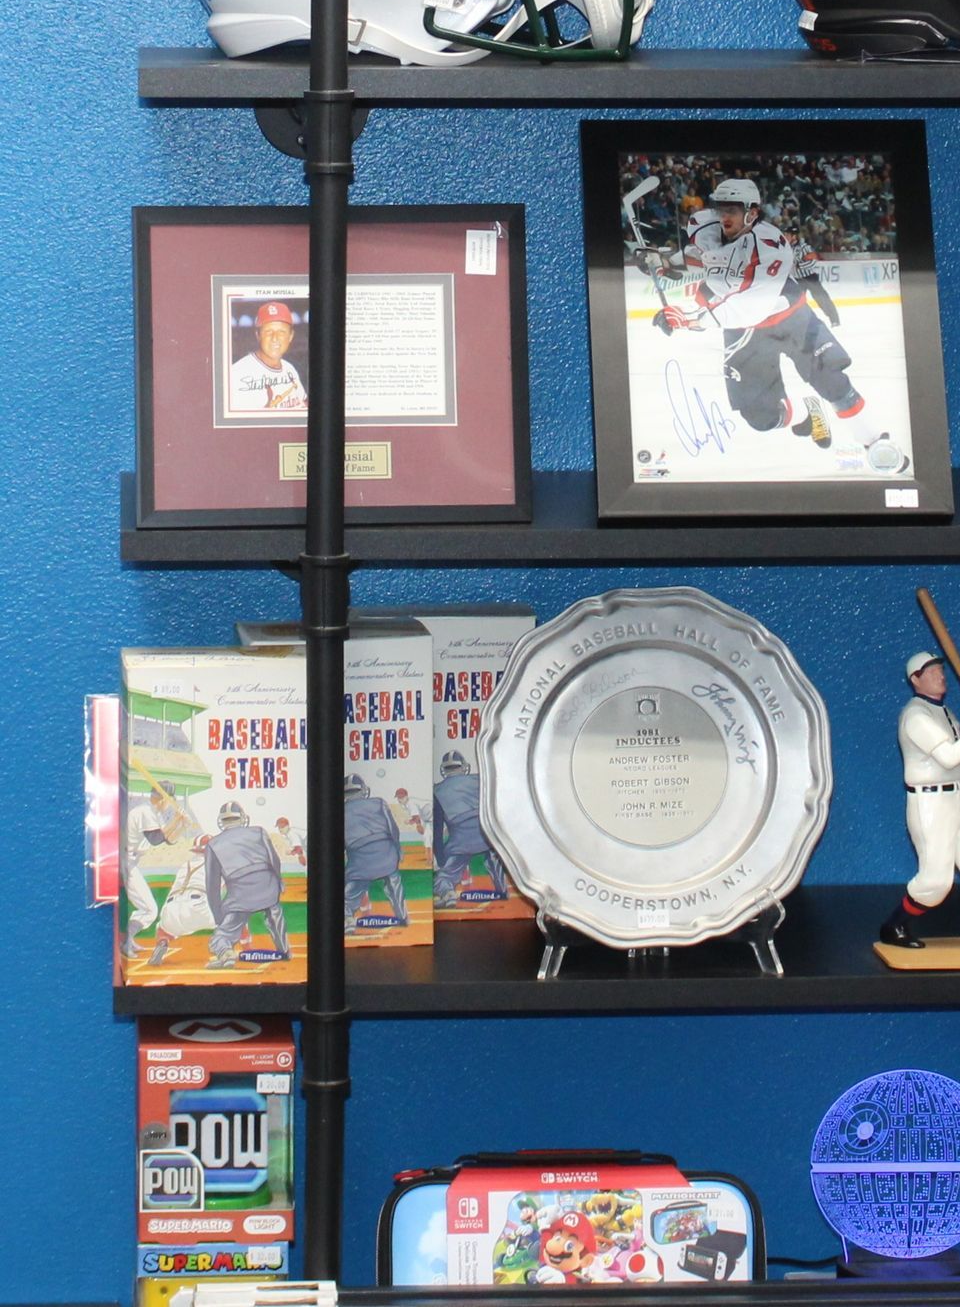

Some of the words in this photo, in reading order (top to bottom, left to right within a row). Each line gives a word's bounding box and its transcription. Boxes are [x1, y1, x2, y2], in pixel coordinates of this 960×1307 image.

[766, 259, 783, 277] 8
[344, 449, 374, 462] usial
[351, 463, 376, 472] Fame
[344, 672, 395, 681] ommemorative
[513, 658, 567, 741] NATIONAL
[571, 622, 659, 658] BASEBALL
[674, 624, 722, 653] HALL
[729, 649, 750, 671] OF
[752, 675, 786, 724] FAME
[432, 670, 504, 702] BASEB
[343, 690, 425, 724] ASEBALL
[447, 708, 481, 740] STA
[349, 728, 410, 761] STARS
[615, 736, 682, 747] INDUCTEES
[608, 755, 648, 765] ANDREW
[652, 754, 690, 764] FOSTER
[224, 756, 289, 791] STARS
[611, 779, 649, 788] ROBERT
[654, 777, 690, 787] GIBSON
[620, 802, 646, 812] JOHN
[660, 800, 684, 810] MIZE
[149, 1067, 202, 1083] ICONS
[171, 1113, 268, 1169] POW
[147, 1167, 199, 1195] POW
[149, 1218, 190, 1233] SUPER
[190, 1218, 233, 1233] MARIO
[143, 1252, 213, 1274] SUPER
